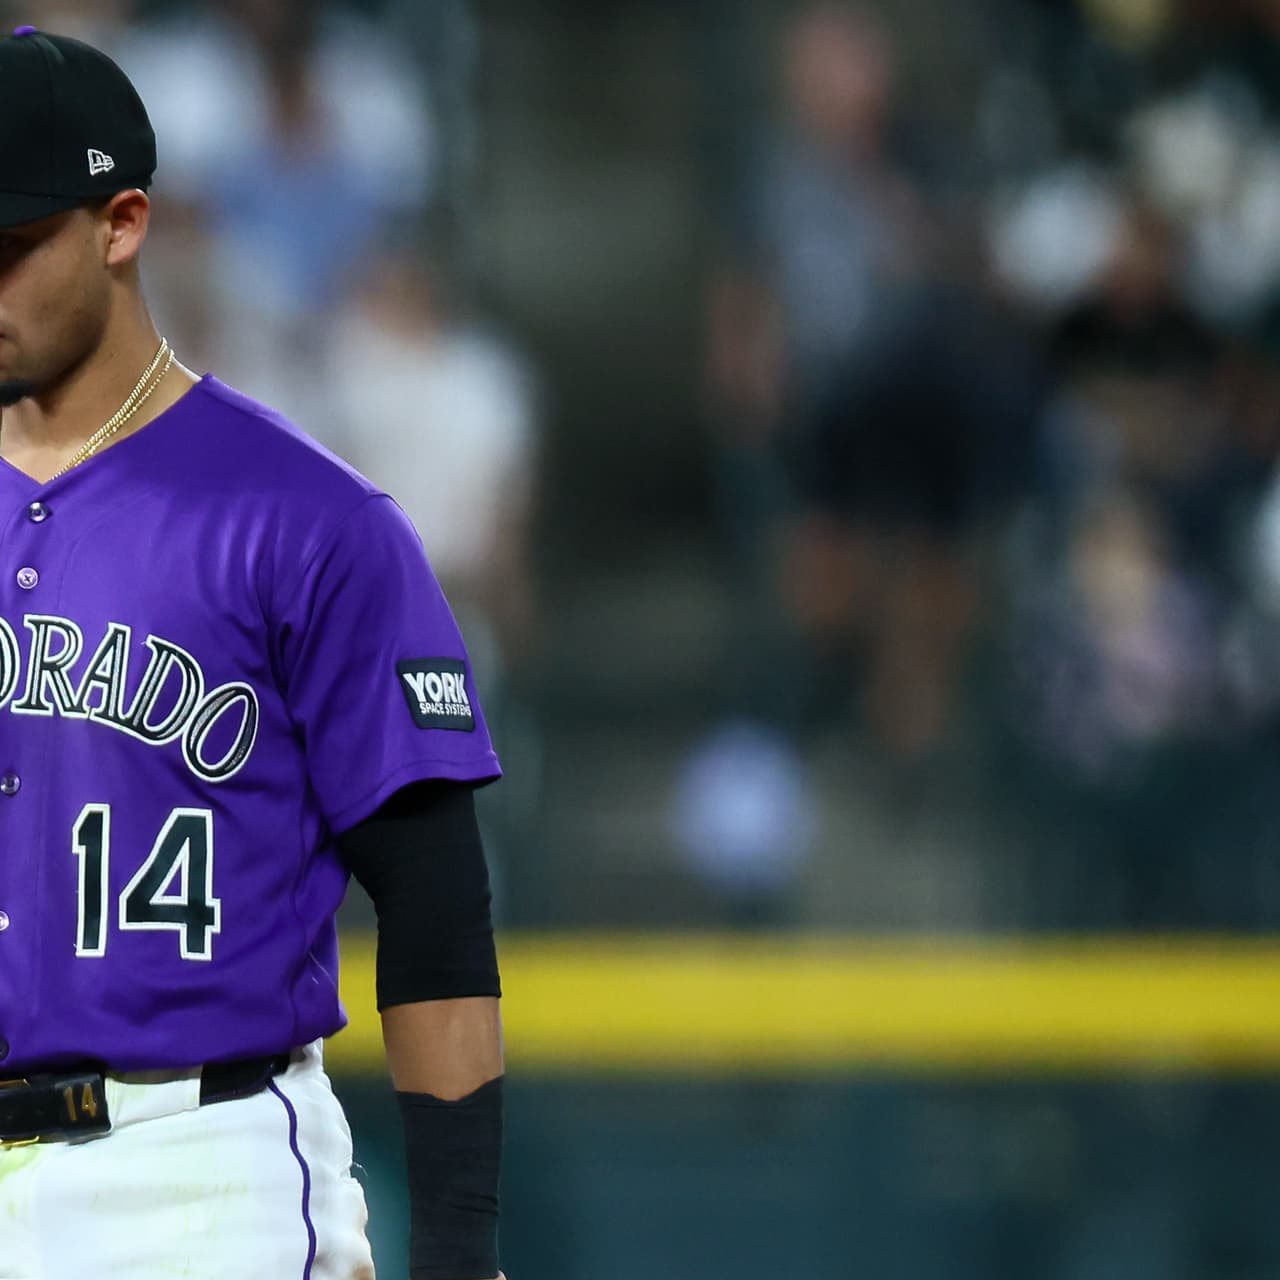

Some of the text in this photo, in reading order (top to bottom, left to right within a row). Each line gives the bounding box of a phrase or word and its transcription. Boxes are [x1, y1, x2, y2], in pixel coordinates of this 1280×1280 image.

[402, 671, 469, 705] YORK
[419, 702, 472, 717] SPACE SYSTEMS
[72, 803, 221, 961] 14
[63, 1082, 98, 1121] 14
